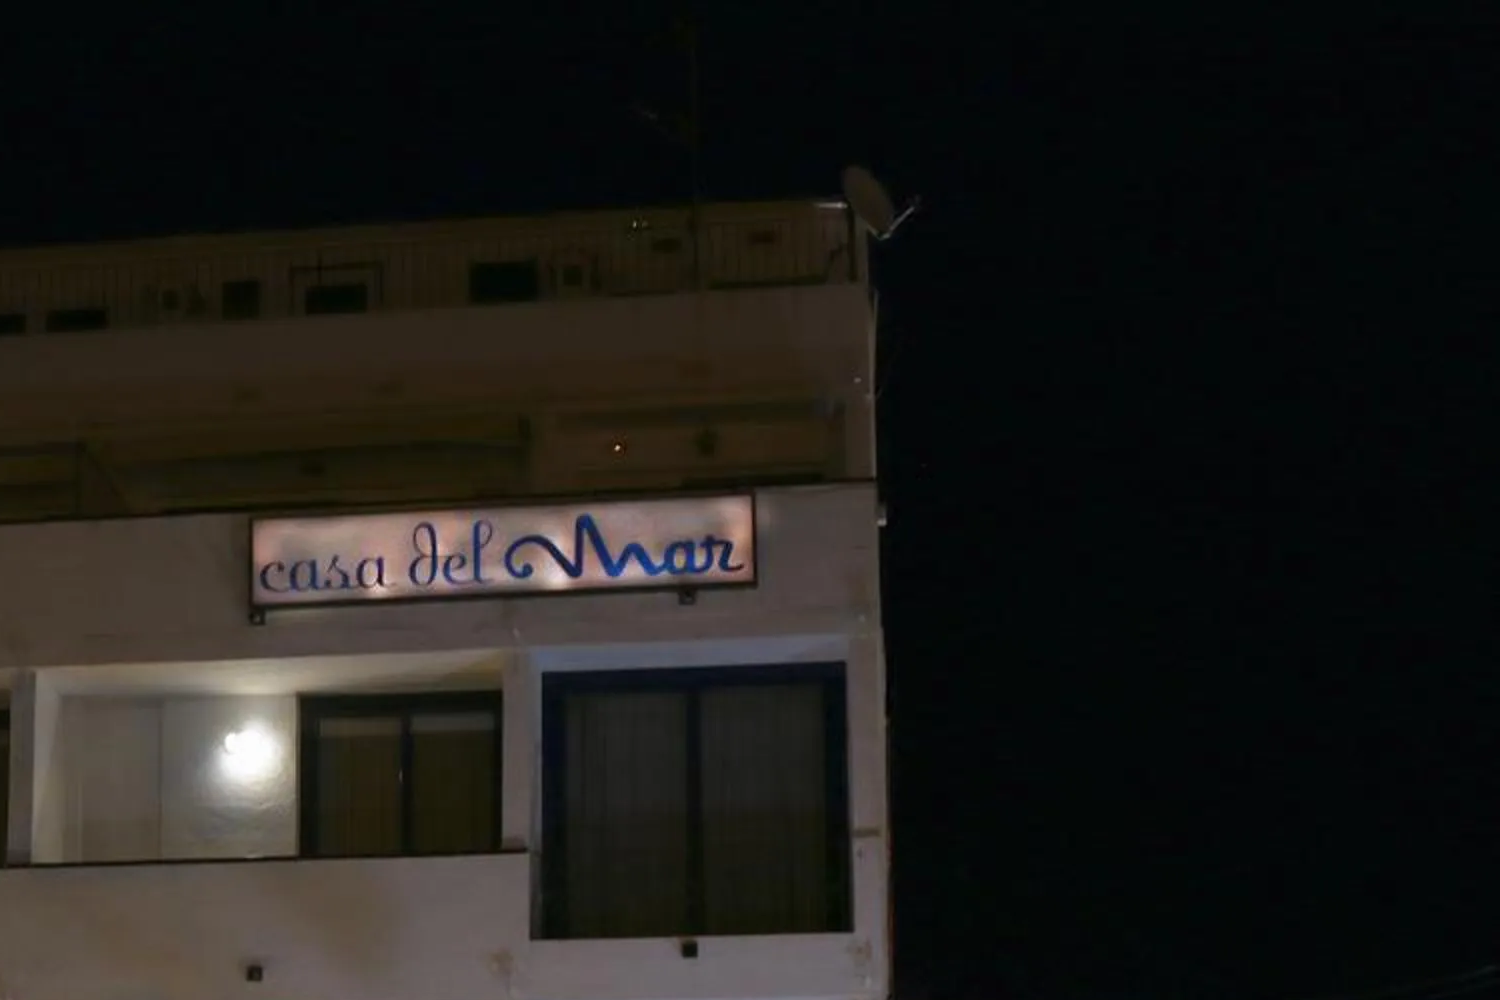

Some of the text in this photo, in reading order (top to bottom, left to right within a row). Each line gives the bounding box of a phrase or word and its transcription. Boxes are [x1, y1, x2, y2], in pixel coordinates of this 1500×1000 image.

[259, 512, 744, 593] casa del Mar
